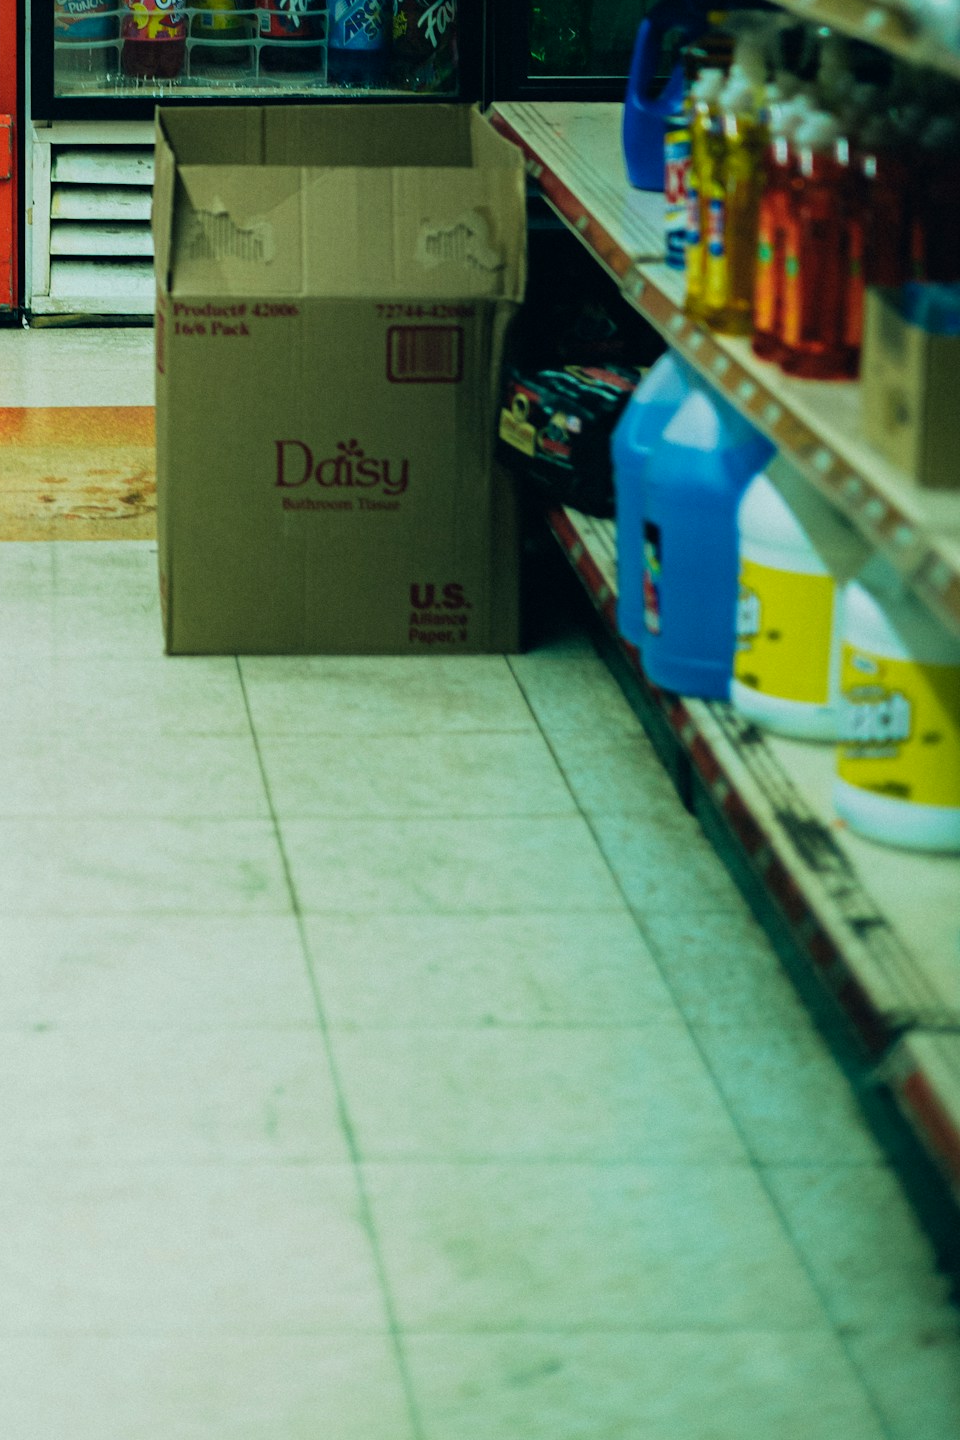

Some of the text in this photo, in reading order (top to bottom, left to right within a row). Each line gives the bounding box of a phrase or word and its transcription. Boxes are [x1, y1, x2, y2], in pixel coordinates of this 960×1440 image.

[211, 322, 250, 336] Pack
[275, 439, 409, 495] Daisy
[282, 497, 401, 510] Bathroom Tissue
[410, 583, 473, 609] U.S.
